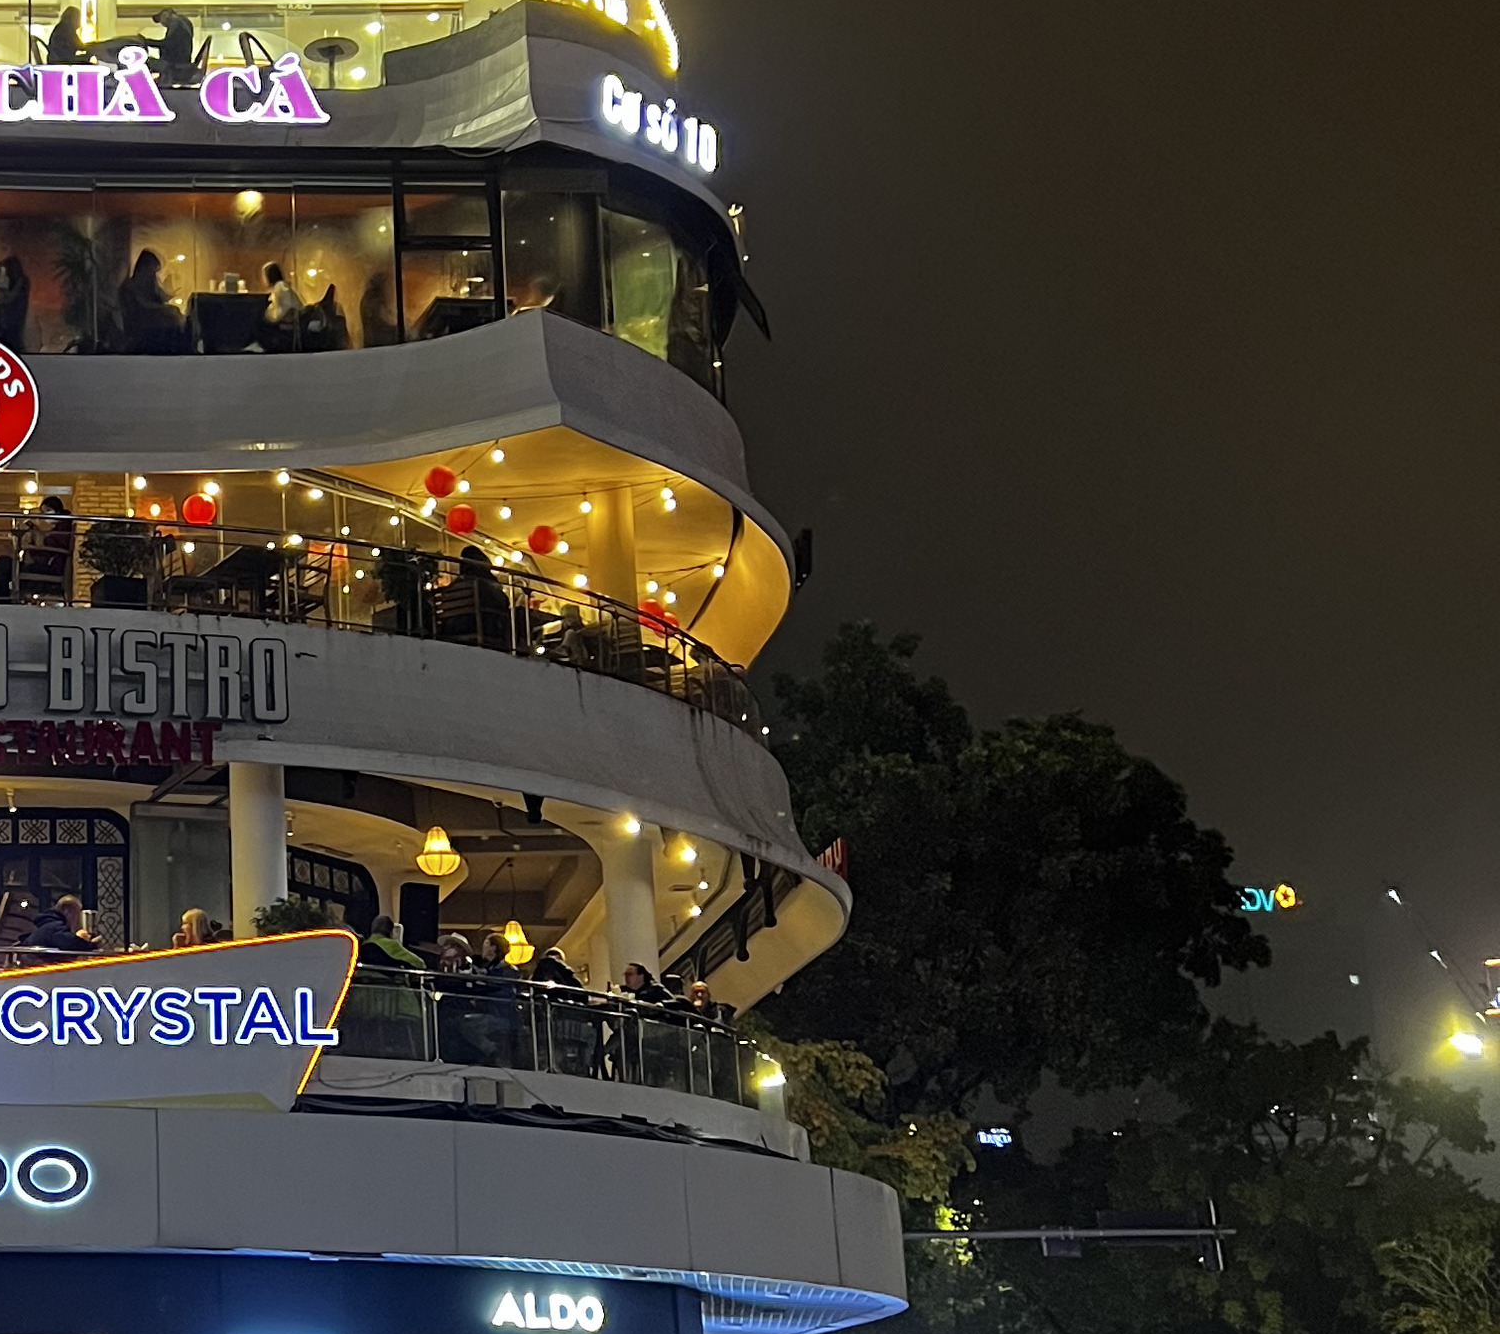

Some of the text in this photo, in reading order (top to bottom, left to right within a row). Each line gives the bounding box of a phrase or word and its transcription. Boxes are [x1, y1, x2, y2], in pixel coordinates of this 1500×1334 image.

[198, 53, 331, 125] CÁ
[684, 116, 719, 174] 10
[44, 624, 290, 724] BISTRO
[490, 1291, 605, 1333] ALDO
